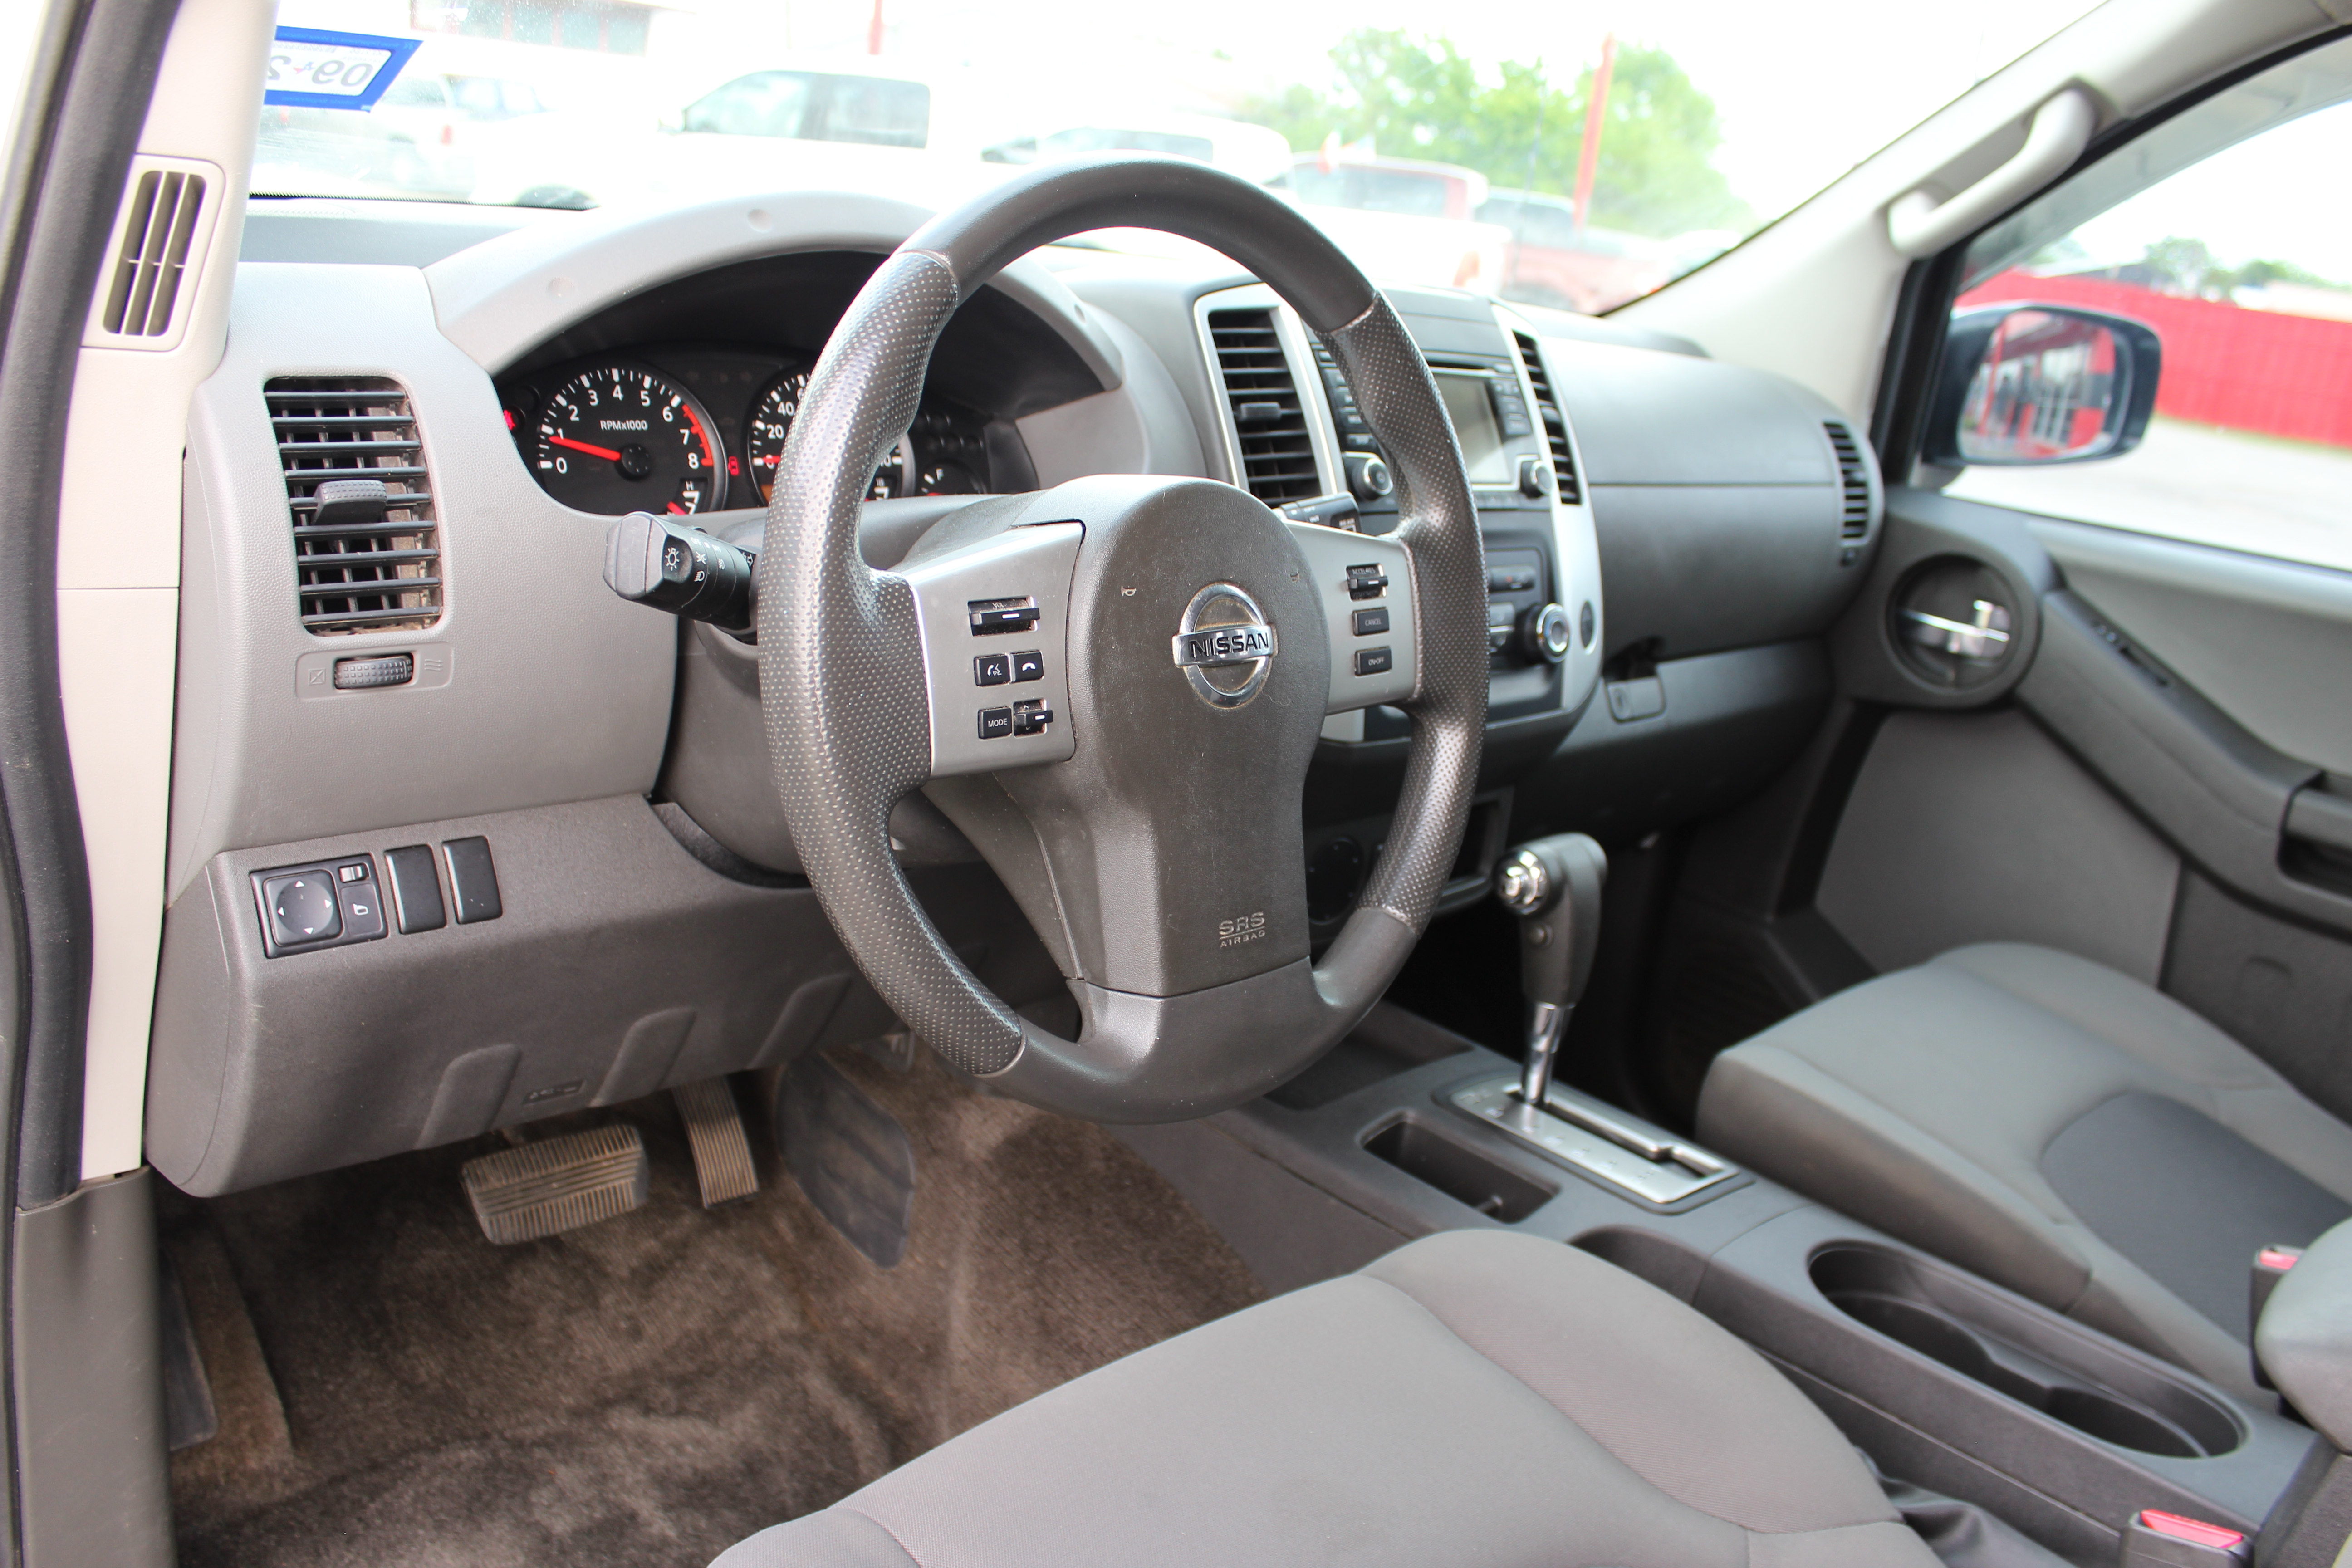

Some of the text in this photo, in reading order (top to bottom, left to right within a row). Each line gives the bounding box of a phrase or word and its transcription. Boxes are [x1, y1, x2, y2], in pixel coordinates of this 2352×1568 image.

[589, 389, 599, 406] 3
[612, 385, 623, 401] 4
[640, 390, 651, 407] 5
[568, 405, 580, 421] 2
[662, 406, 673, 422] 6
[777, 401, 795, 416] 40
[600, 420, 648, 431] RPMx1000
[766, 424, 785, 439] 20
[680, 428, 690, 445] 7
[556, 457, 568, 474] 0
[688, 452, 699, 470] 8
[936, 468, 944, 481] F
[685, 481, 695, 490] H
[1364, 618, 1382, 626] CANCEL
[1189, 632, 1269, 658] NISSAN
[988, 718, 1008, 728] MODE
[1218, 911, 1265, 935] SRS
[1220, 930, 1265, 948] AIRBAG
